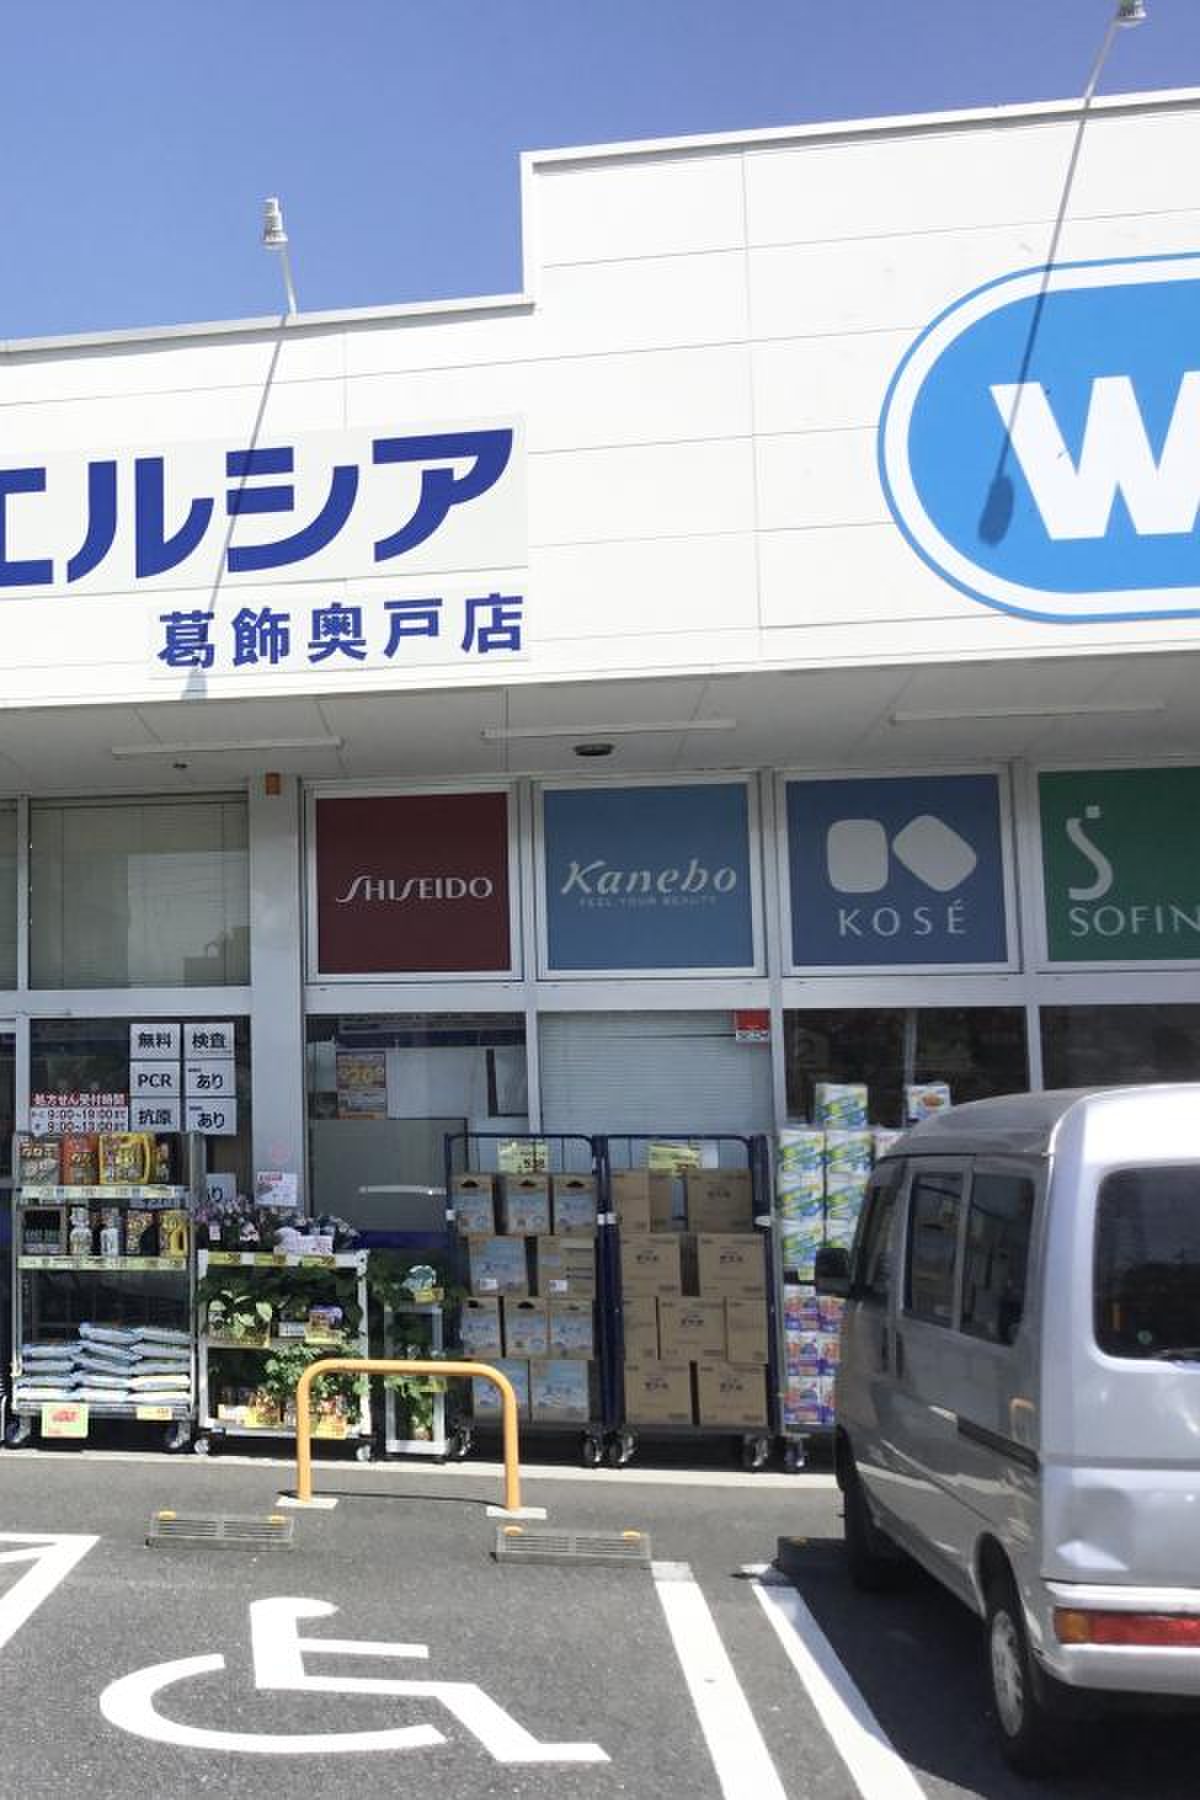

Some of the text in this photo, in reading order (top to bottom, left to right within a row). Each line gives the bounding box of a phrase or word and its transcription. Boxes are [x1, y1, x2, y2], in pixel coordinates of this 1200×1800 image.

[158, 593, 523, 668] 葛飾奥戸店
[561, 858, 737, 894] Kanebo
[336, 875, 493, 902] SHISEIDO
[839, 899, 966, 936] KOSÉ
[138, 1032, 172, 1048] 無料
[192, 1032, 225, 1049] 検査
[137, 1073, 172, 1088] PCR
[196, 1073, 224, 1089] あり
[138, 1109, 172, 1125] 抗原
[197, 1112, 225, 1128] あり
